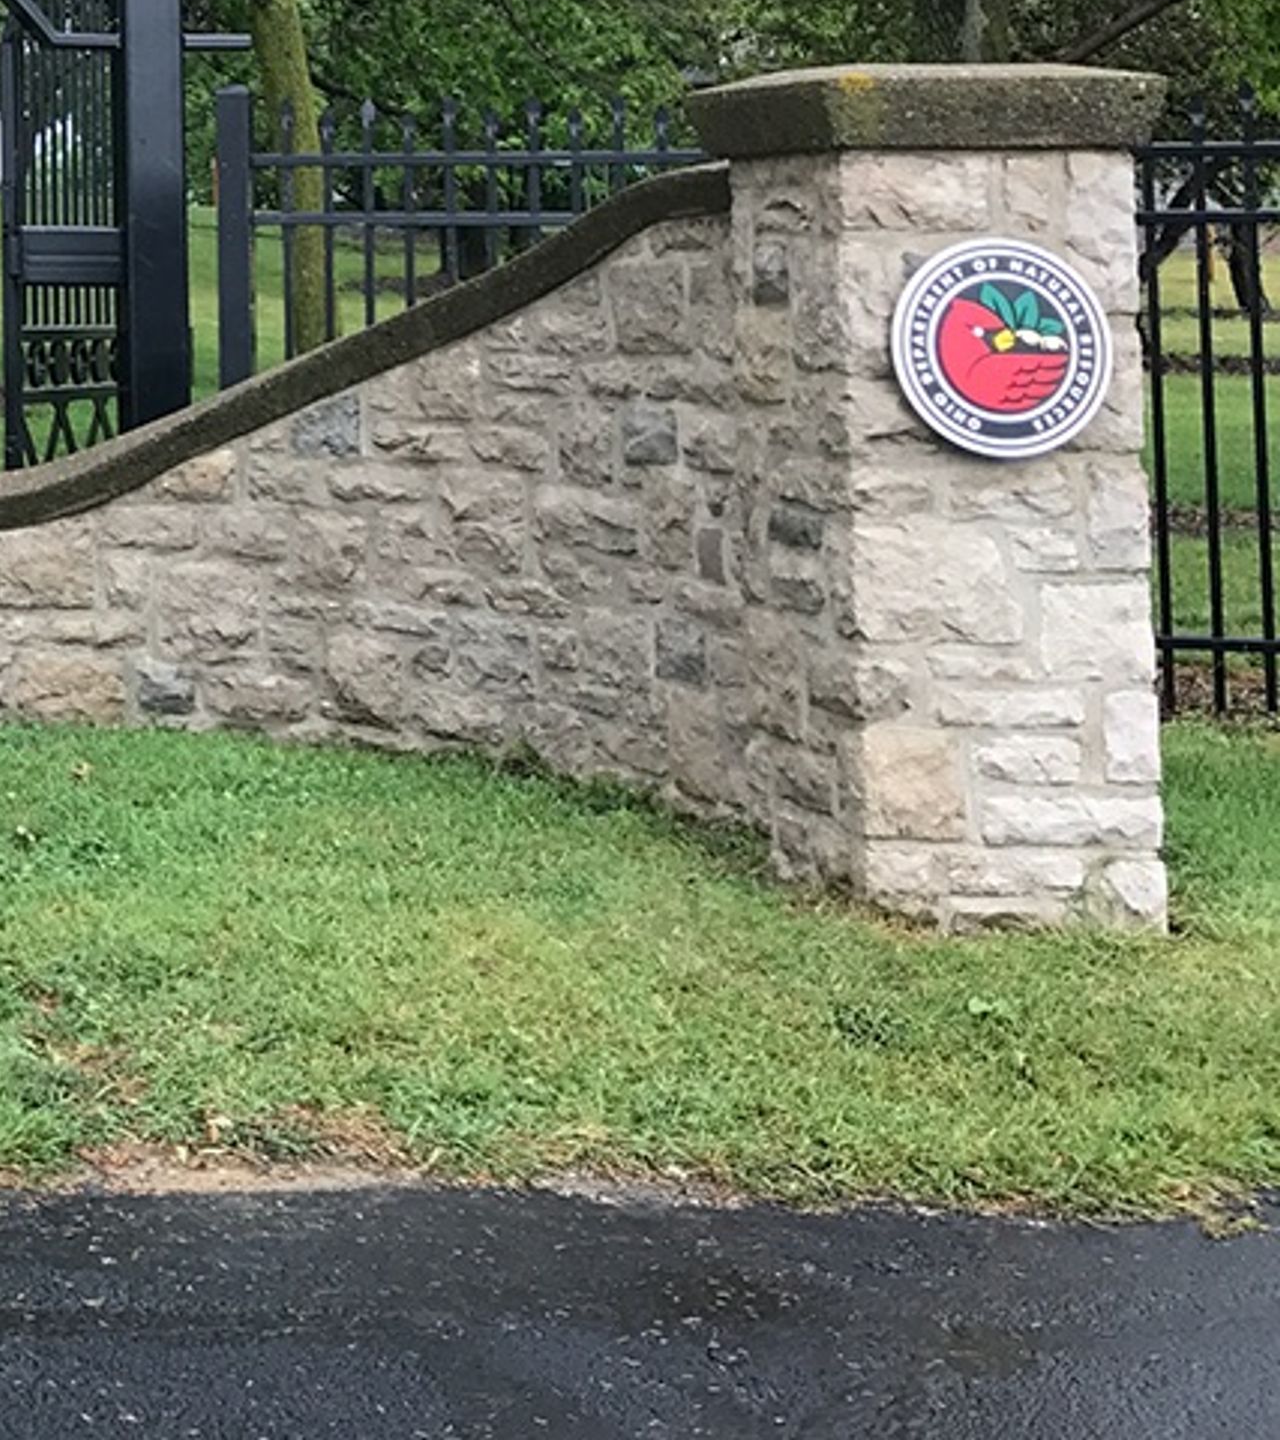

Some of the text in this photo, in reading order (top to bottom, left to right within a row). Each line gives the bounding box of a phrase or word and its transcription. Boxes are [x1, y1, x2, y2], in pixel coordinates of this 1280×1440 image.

[971, 258, 998, 272] OF
[1009, 259, 1087, 325] NATURAL
[911, 265, 965, 386] DEPARTMENT
[933, 392, 983, 431] OHIO
